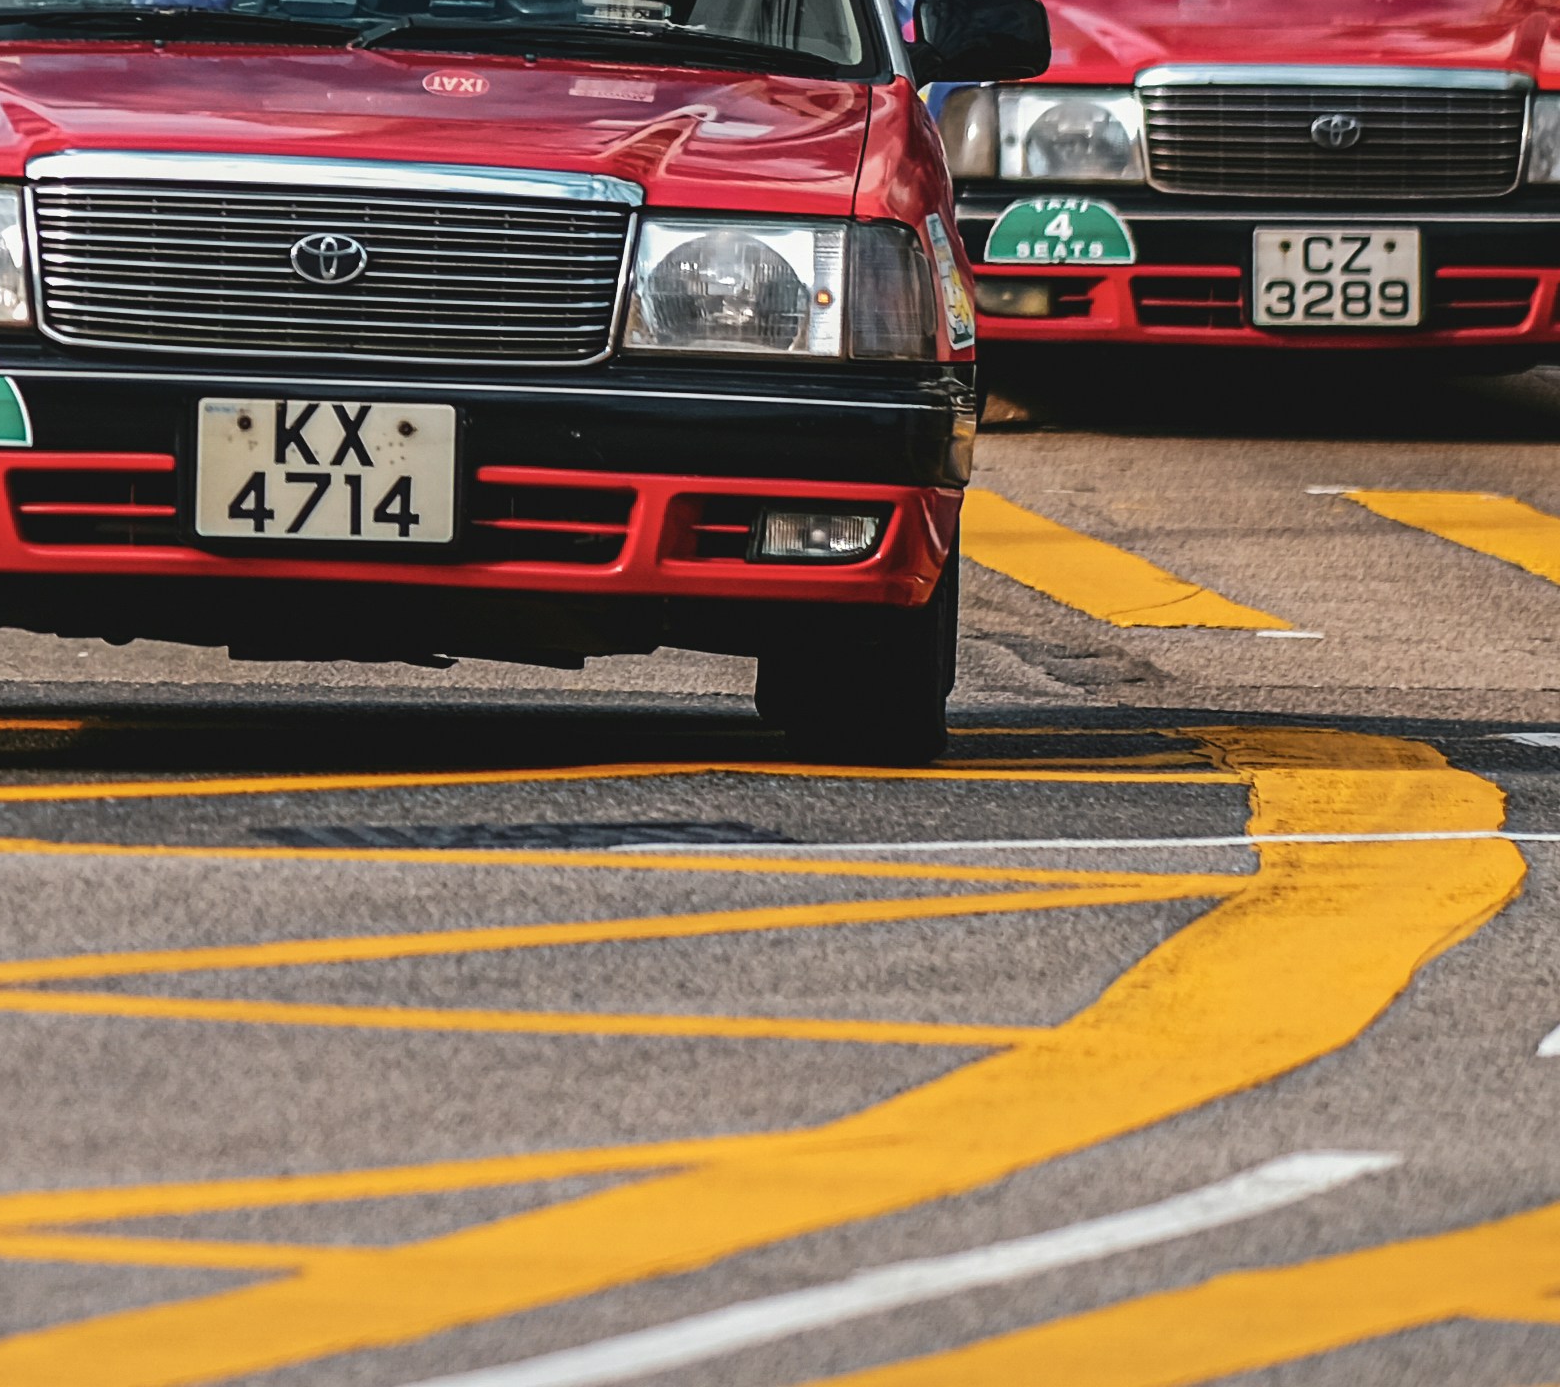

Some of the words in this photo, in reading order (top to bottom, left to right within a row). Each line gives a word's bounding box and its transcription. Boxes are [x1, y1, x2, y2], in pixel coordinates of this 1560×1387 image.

[1044, 212, 1073, 241] 4
[1016, 241, 1105, 259] SEATS
[1301, 236, 1373, 276] CZ
[1264, 279, 1410, 320] 3289
[274, 400, 375, 468] KX
[227, 470, 421, 538] 4714
